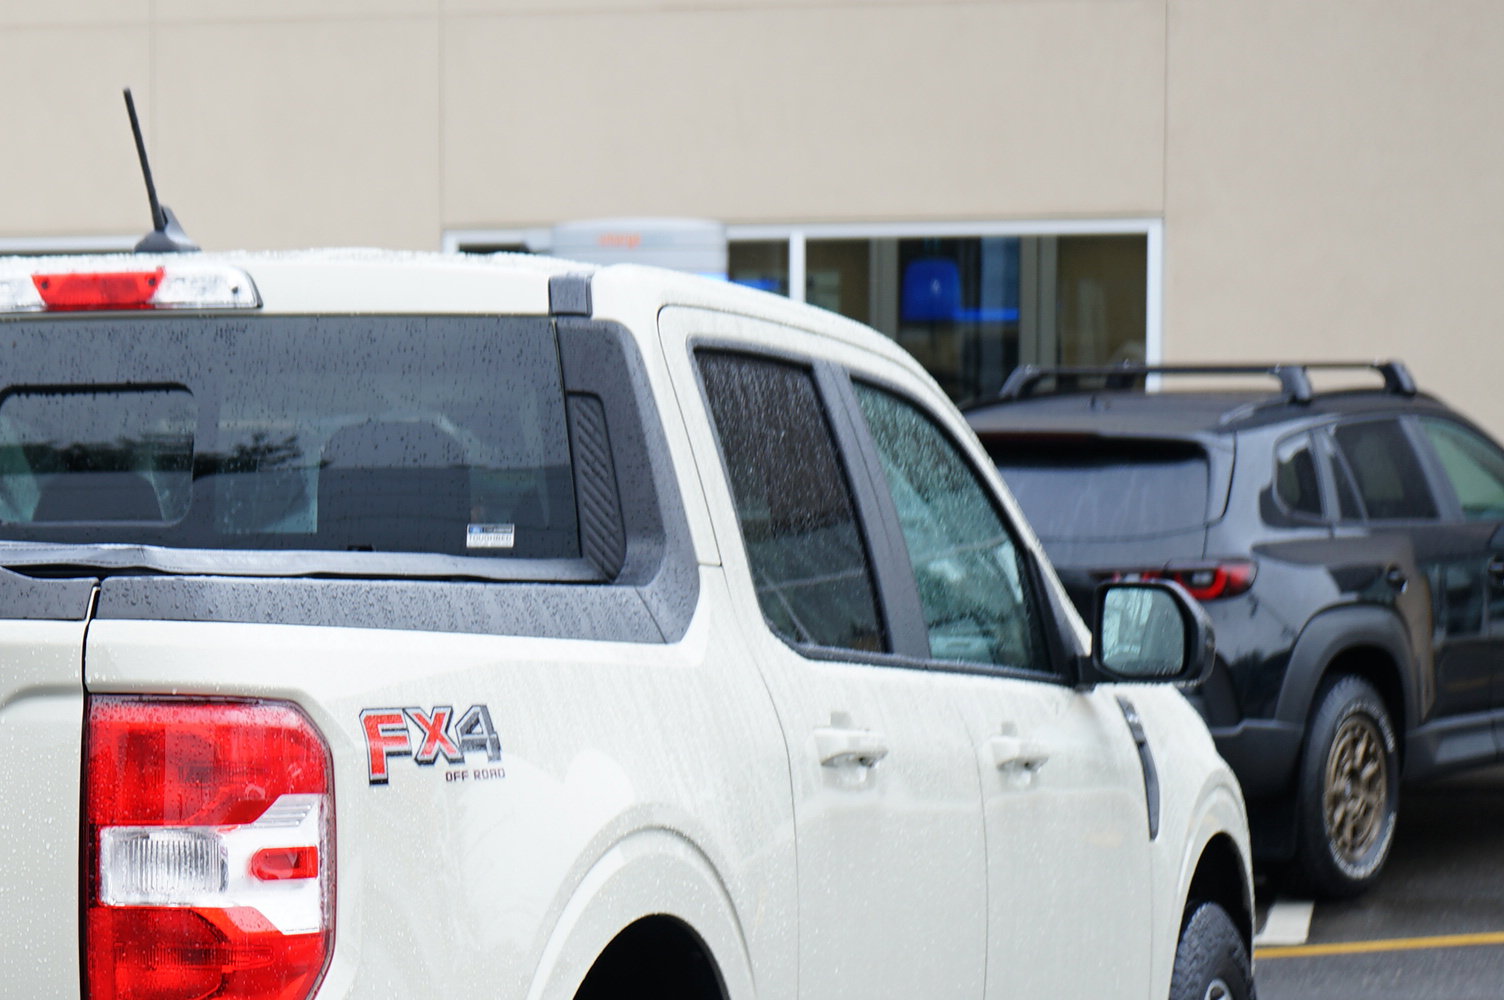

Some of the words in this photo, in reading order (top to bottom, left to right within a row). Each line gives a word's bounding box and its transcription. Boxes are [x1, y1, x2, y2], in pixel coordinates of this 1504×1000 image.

[359, 704, 502, 785] FX4
[445, 770, 470, 782] OFF
[473, 768, 506, 781] ROAD
